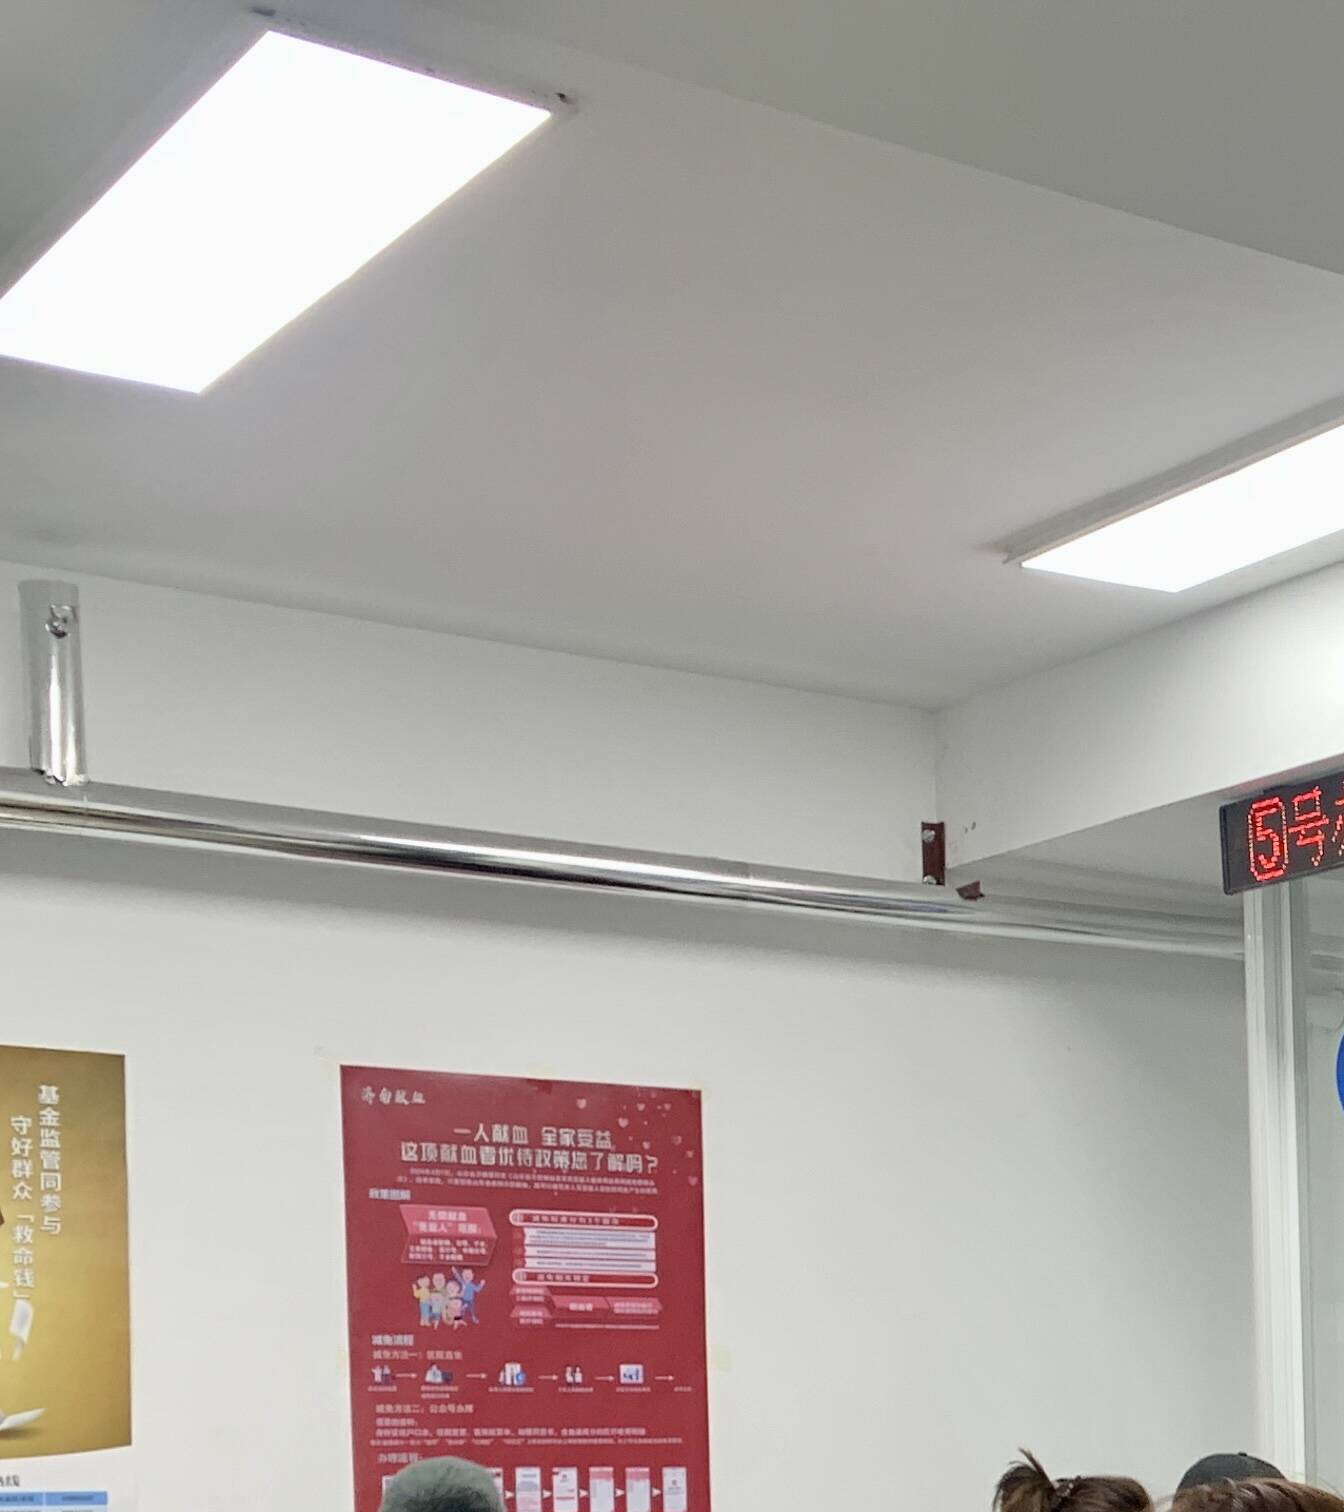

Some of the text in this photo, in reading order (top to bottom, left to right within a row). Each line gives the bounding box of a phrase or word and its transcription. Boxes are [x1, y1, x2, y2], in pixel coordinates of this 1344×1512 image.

[38, 1084, 62, 1235] 基金监管同参与
[453, 1123, 613, 1149] 一人献血 全家受益
